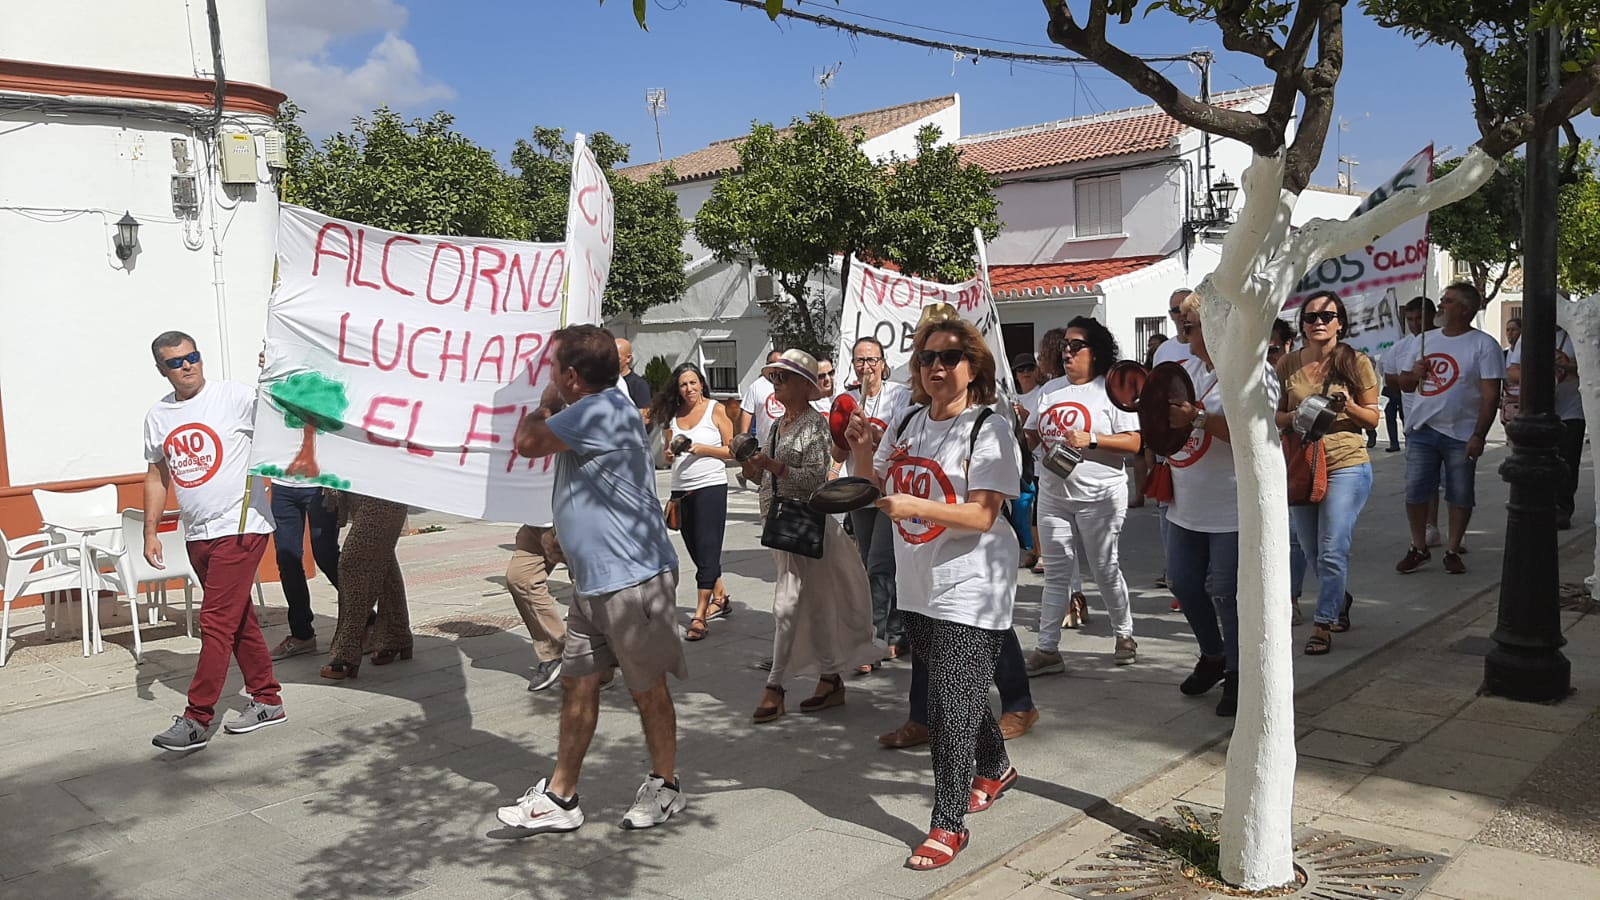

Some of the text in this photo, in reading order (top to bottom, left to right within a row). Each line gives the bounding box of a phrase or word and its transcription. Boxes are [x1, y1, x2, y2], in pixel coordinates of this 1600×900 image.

[311, 222, 566, 315] ALCORNO
[362, 395, 434, 458] EL
[1046, 408, 1079, 428] NO
[171, 431, 205, 457] NO
[893, 467, 931, 500] NO
